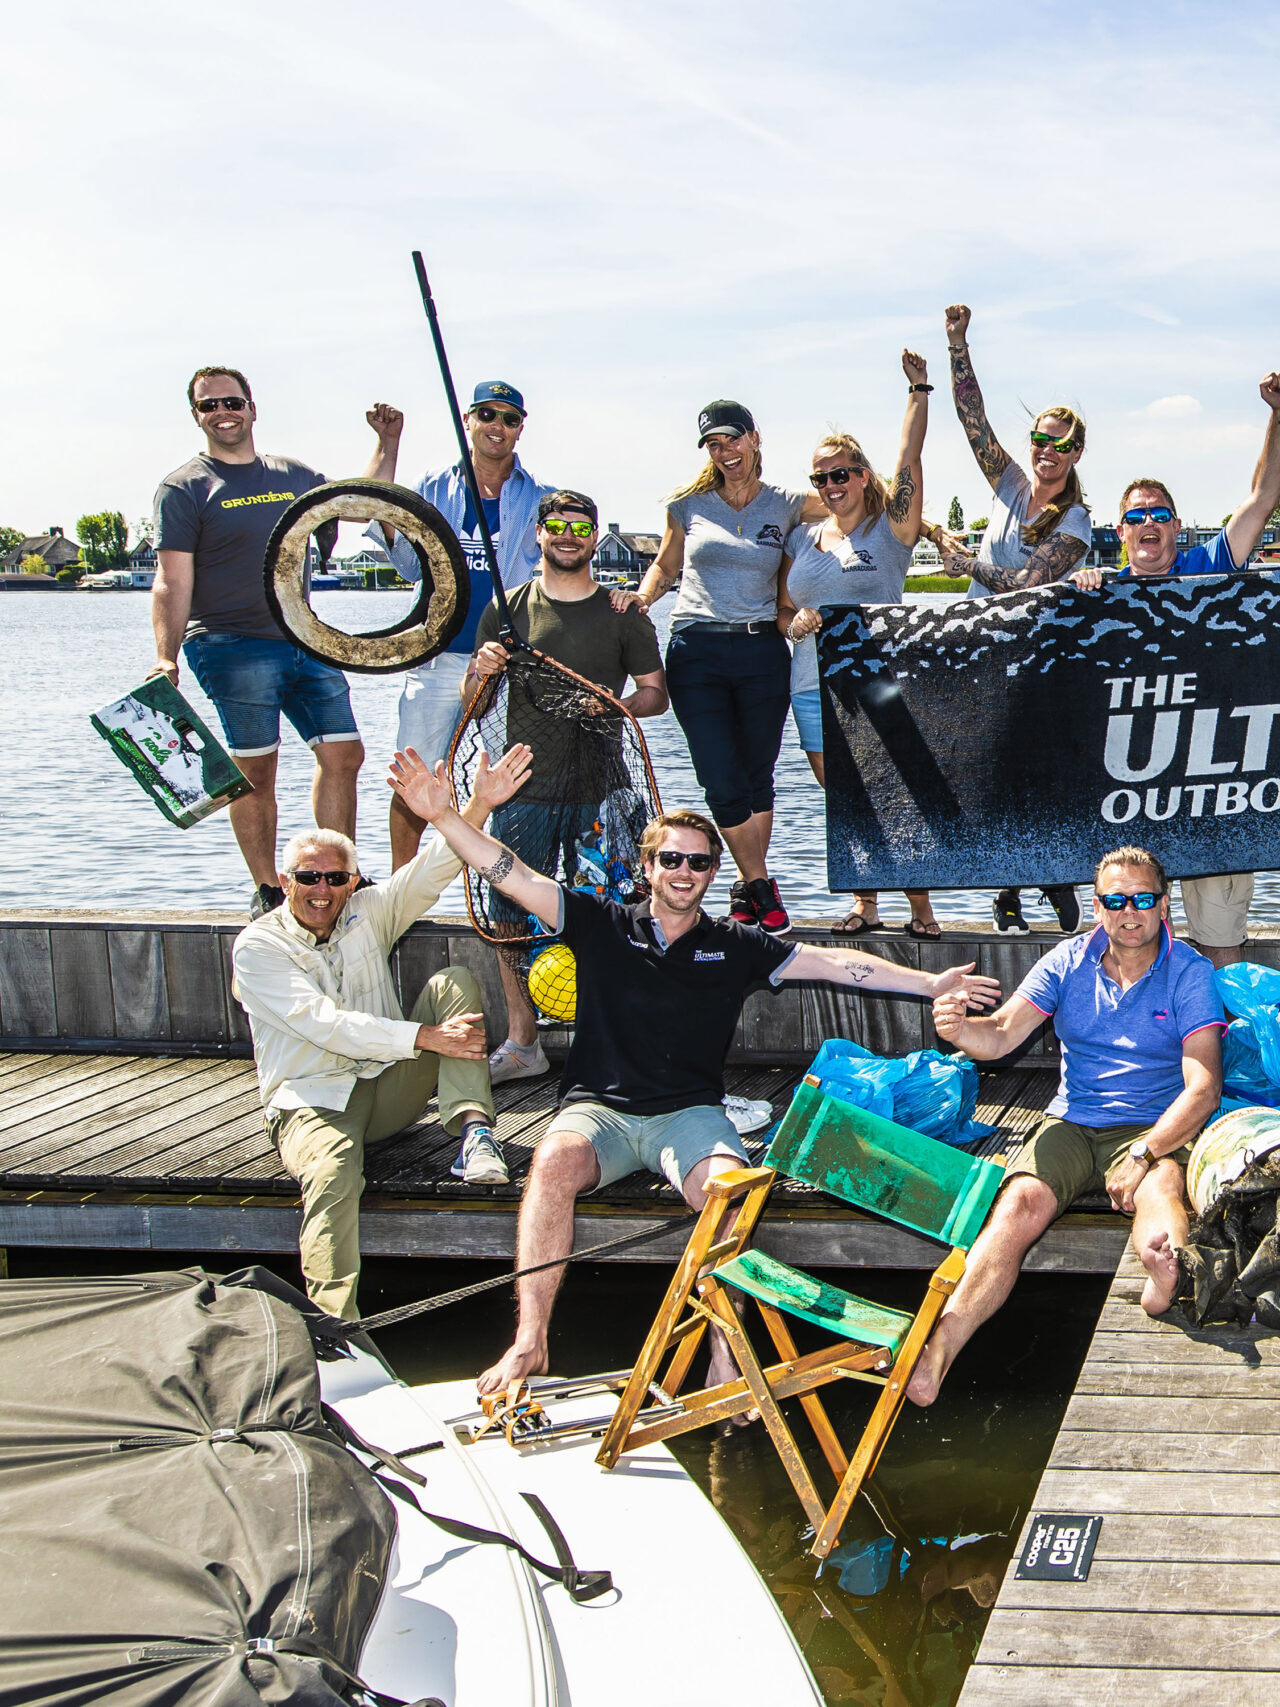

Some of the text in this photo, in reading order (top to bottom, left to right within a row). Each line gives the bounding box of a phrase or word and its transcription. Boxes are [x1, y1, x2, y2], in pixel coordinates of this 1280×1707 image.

[1103, 673, 1198, 708] THE
[1025, 1524, 1047, 1567] cooper
[1048, 1528, 1081, 1566] C25
